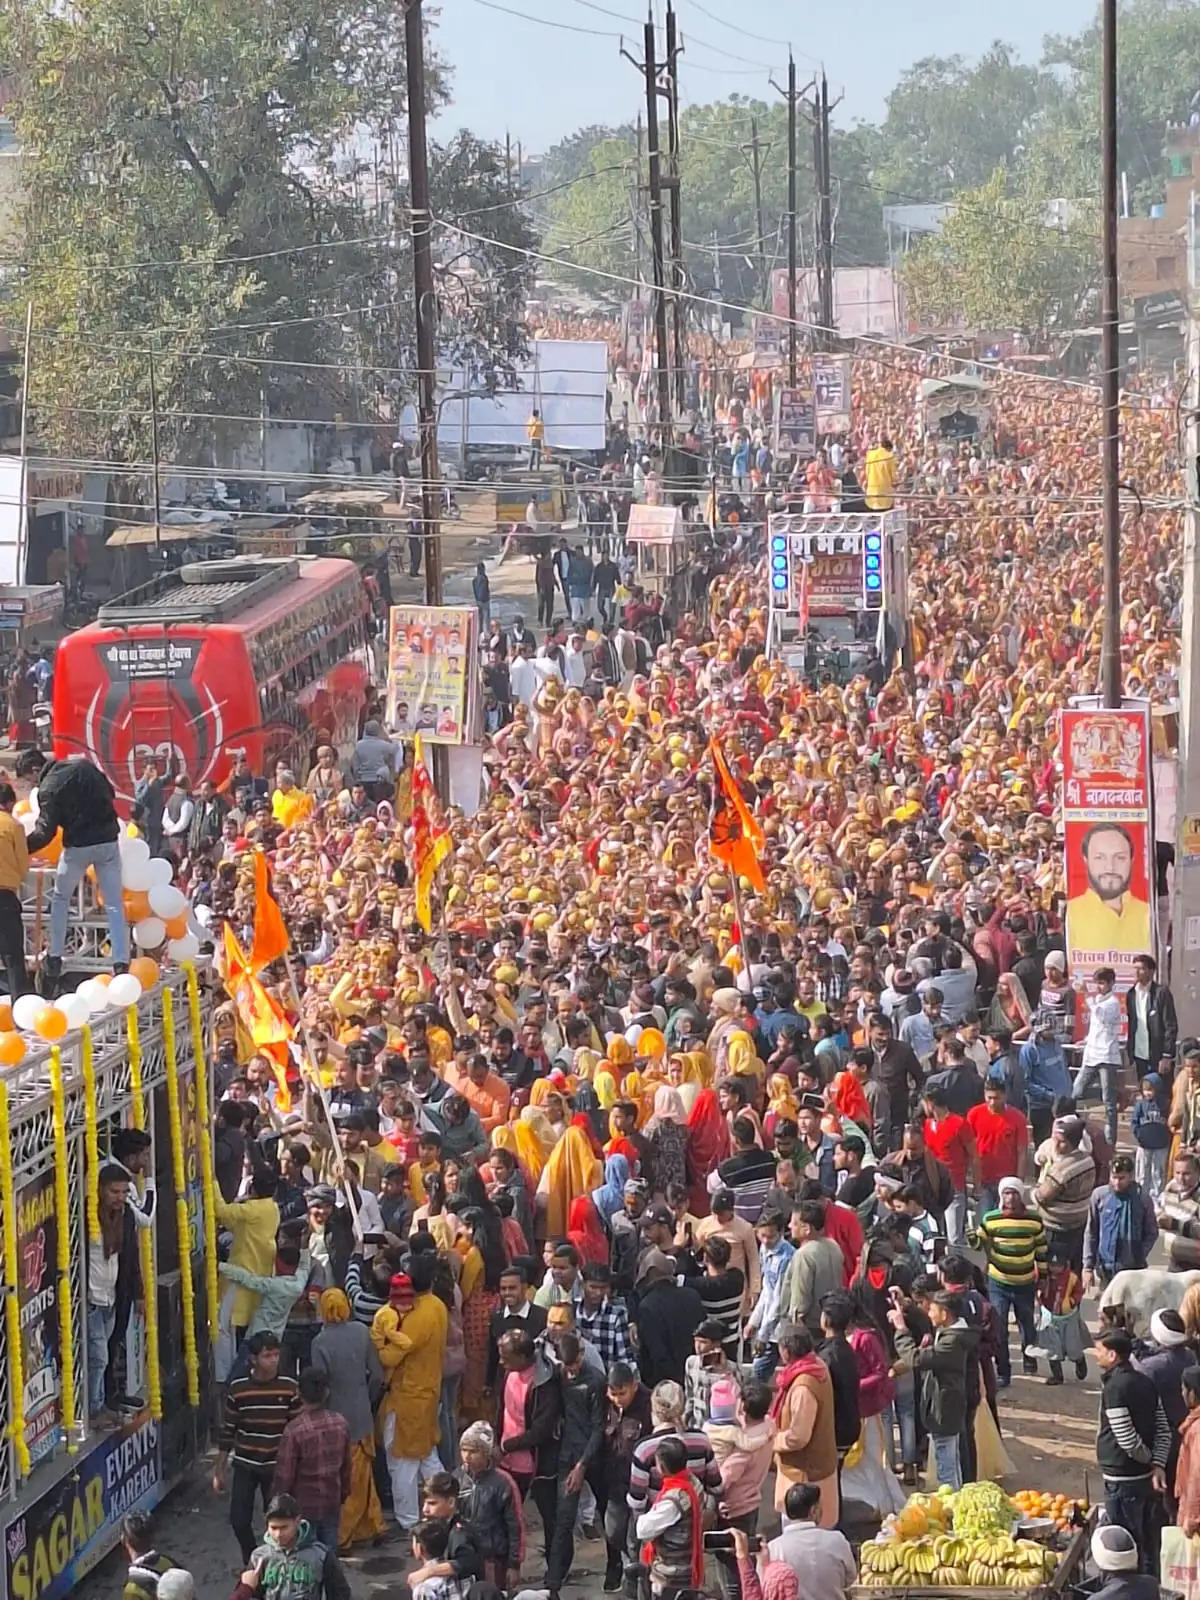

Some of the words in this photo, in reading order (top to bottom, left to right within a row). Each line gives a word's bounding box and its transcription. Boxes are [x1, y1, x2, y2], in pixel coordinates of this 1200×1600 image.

[1066, 779, 1080, 804] श्री
[20, 1285, 54, 1328] EVENTS
[105, 1424, 157, 1489] EVENTS
[110, 1458, 157, 1524] KARERA
[12, 1473, 105, 1600] SAGAR
